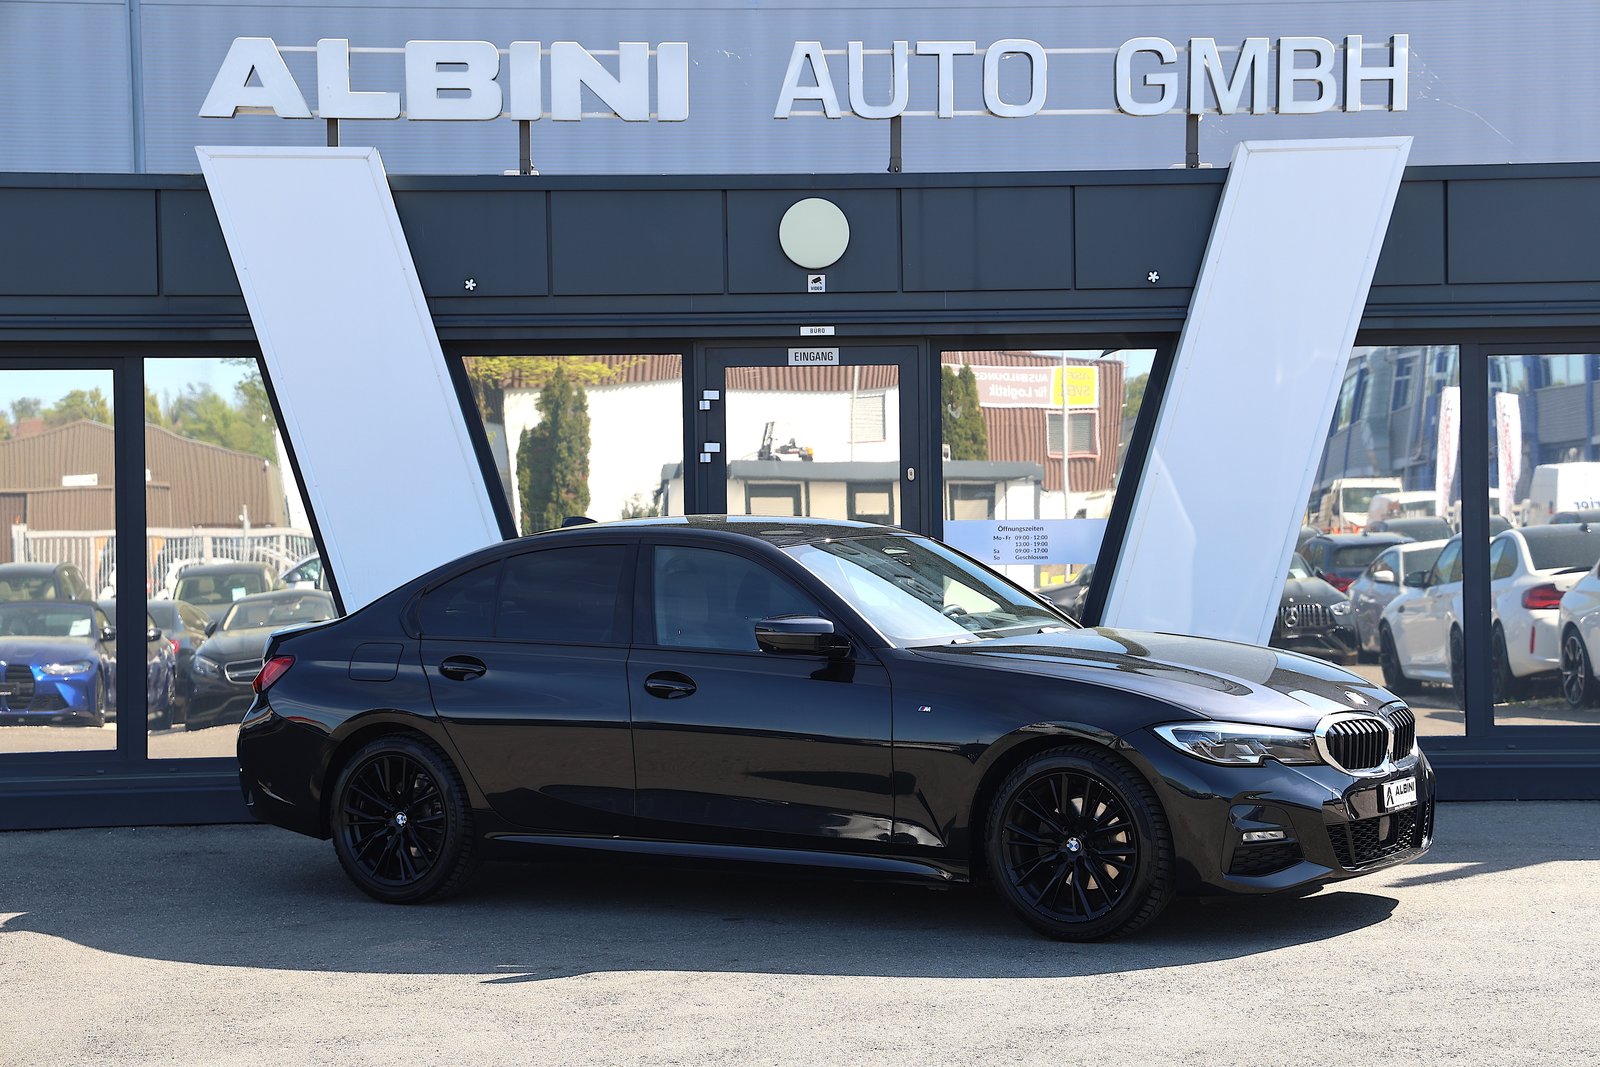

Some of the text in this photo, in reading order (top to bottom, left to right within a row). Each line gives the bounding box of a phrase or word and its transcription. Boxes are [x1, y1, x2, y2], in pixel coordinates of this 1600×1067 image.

[198, 33, 1409, 122] ALBINI AUTO GMBH
[794, 351, 834, 362] EINGANG
[1395, 781, 1415, 796] ALBINI
